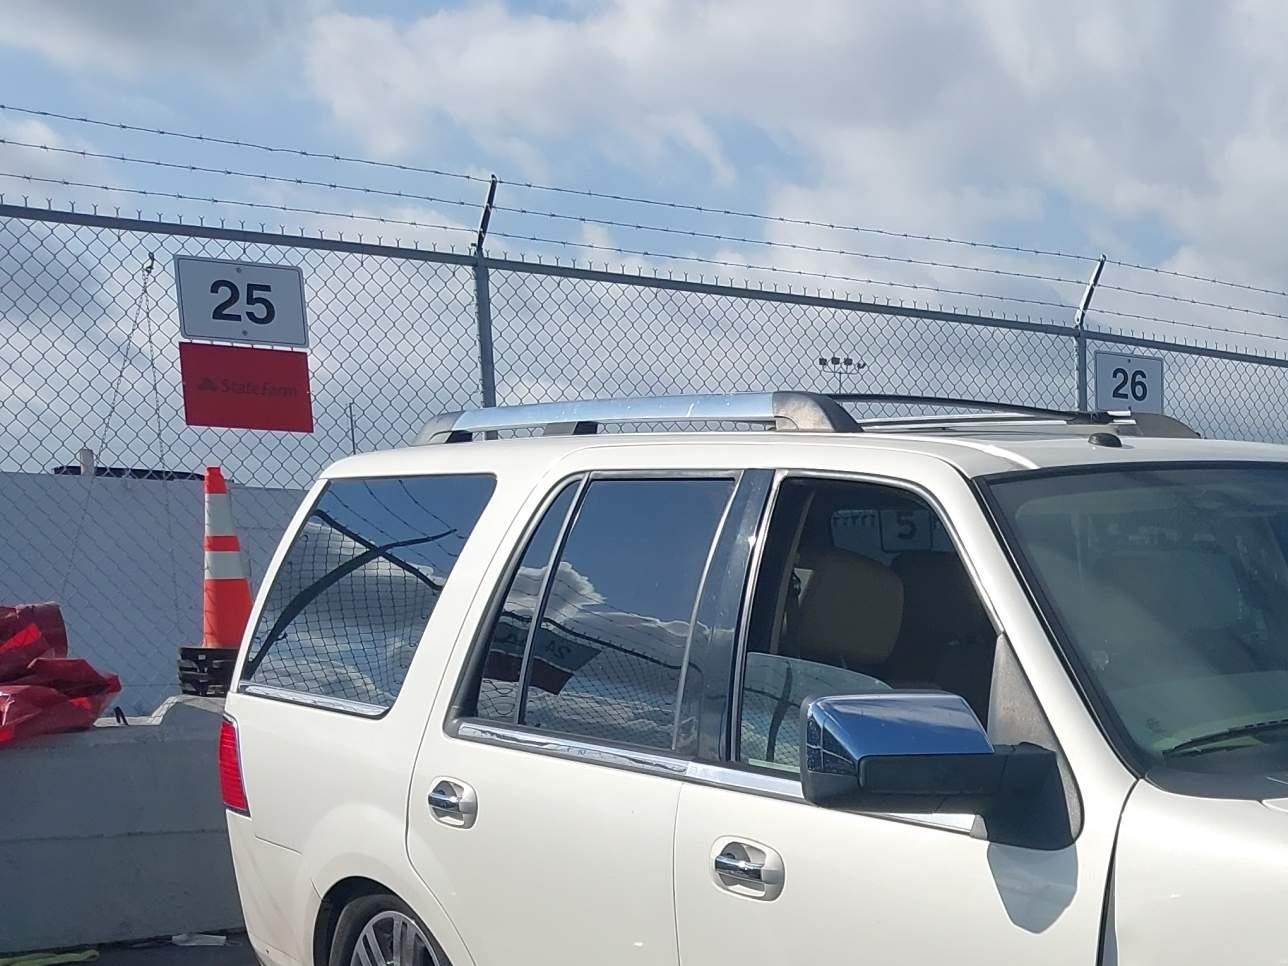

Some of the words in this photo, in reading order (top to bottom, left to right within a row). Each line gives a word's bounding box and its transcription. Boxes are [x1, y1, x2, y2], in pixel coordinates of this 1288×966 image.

[210, 279, 276, 325] 25
[221, 378, 258, 394] State
[1112, 367, 1148, 402] 26
